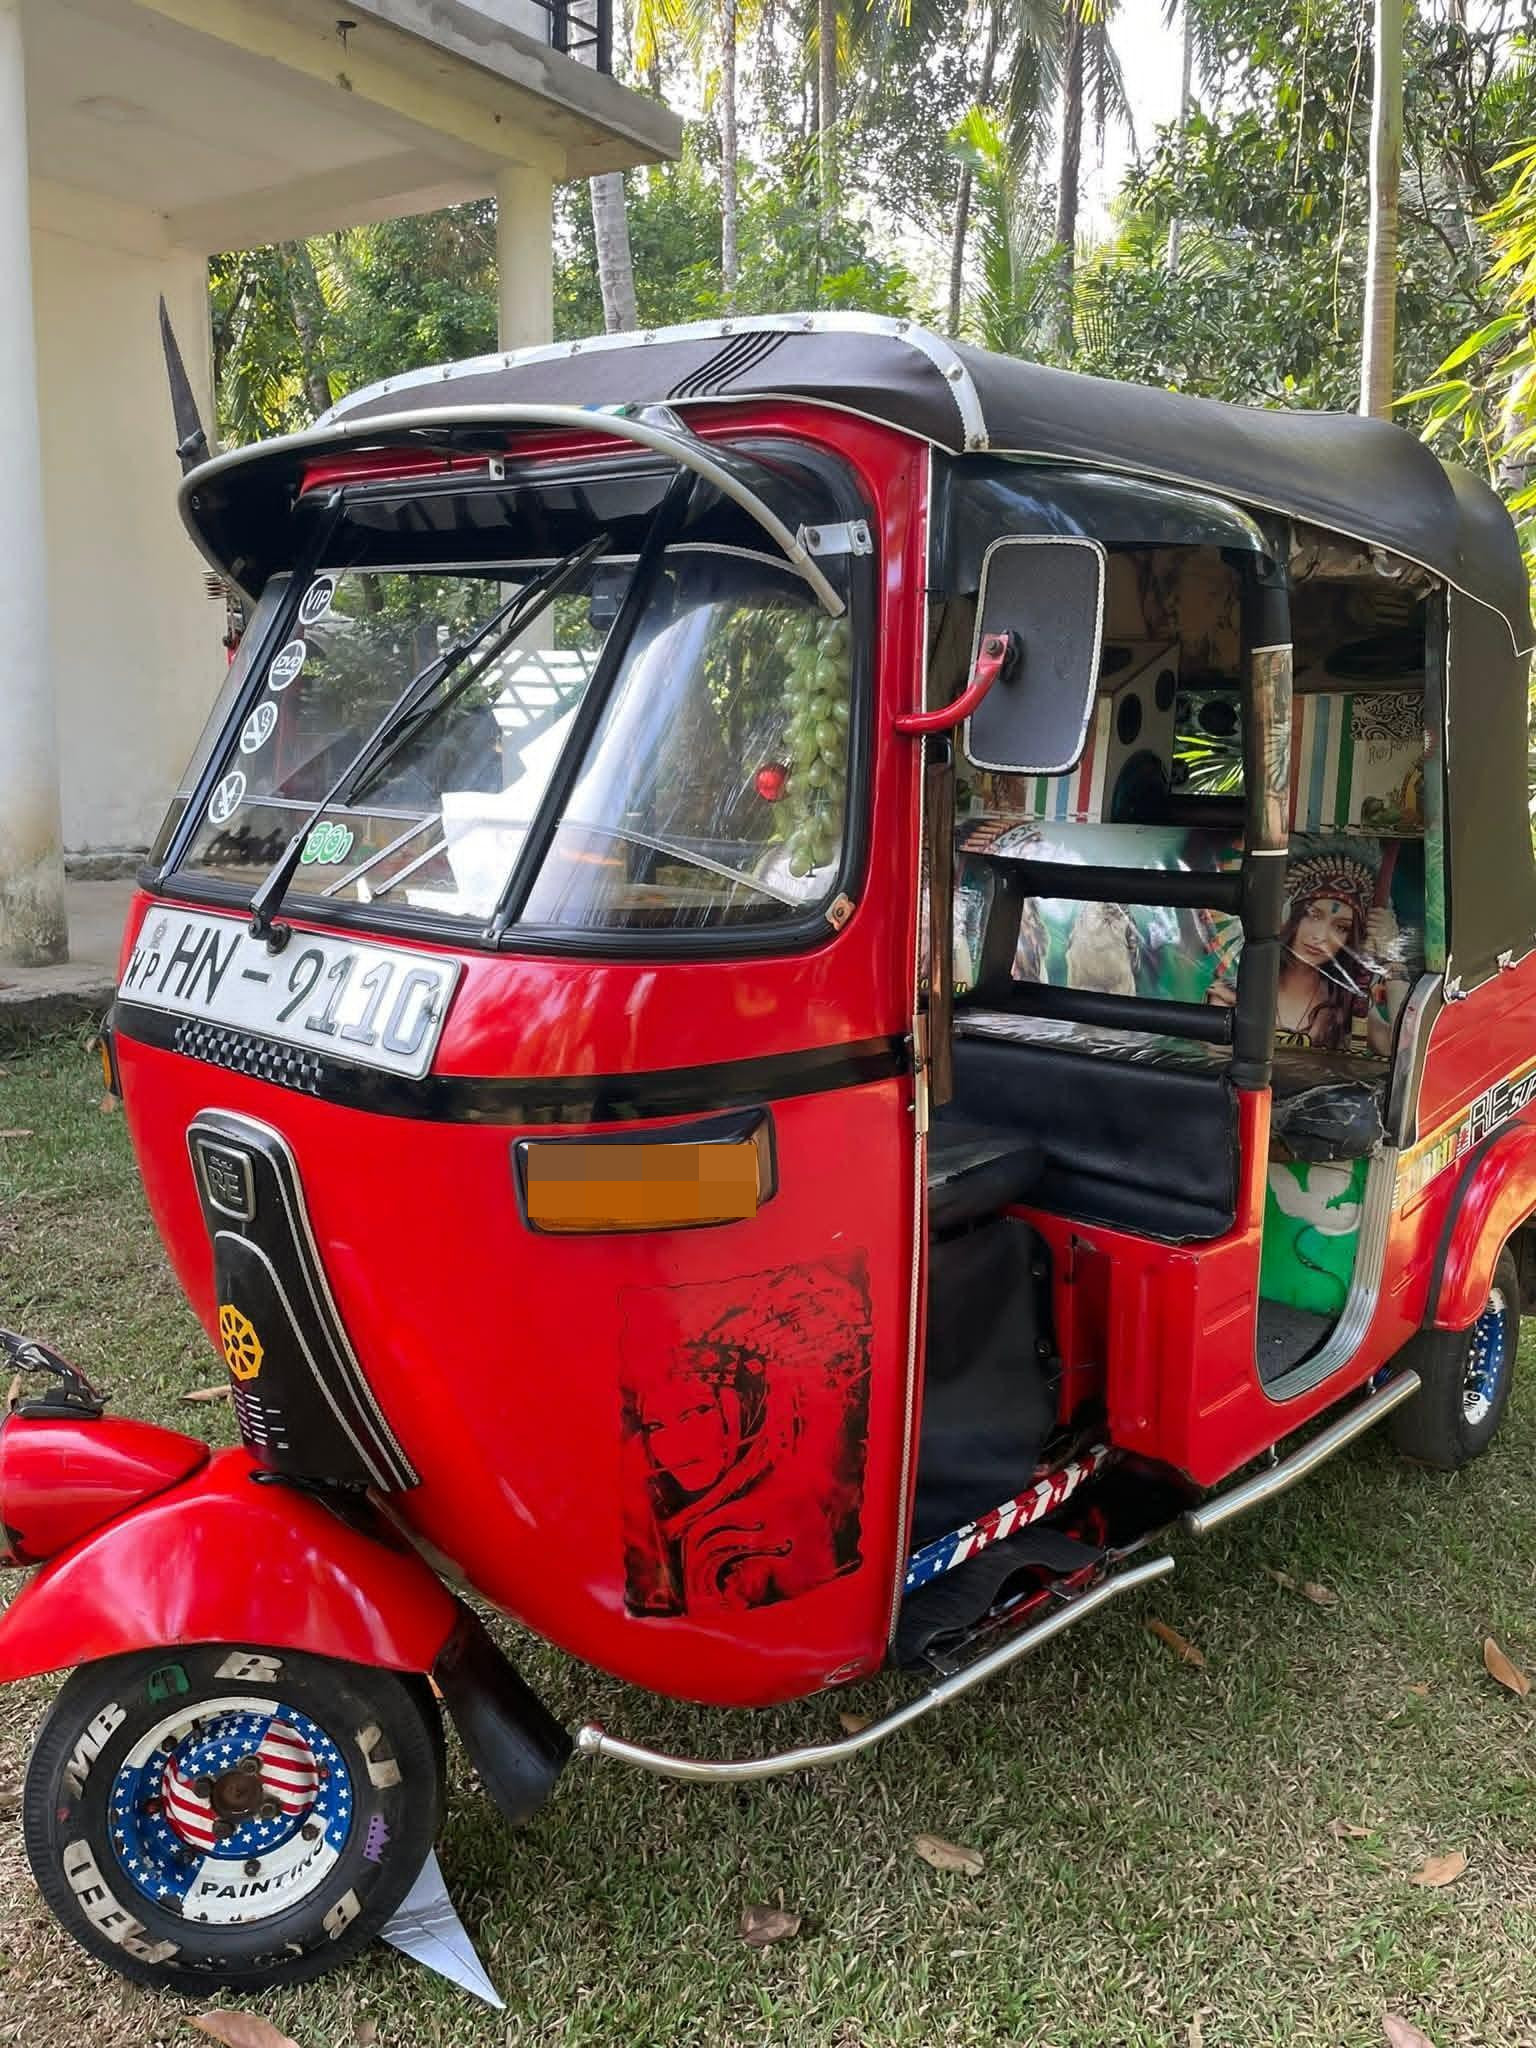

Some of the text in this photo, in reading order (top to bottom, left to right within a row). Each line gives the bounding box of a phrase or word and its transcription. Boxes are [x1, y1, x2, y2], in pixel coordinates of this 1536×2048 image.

[305, 589, 331, 610] VIP
[275, 655, 301, 669] DVD
[125, 949, 161, 989] WP
